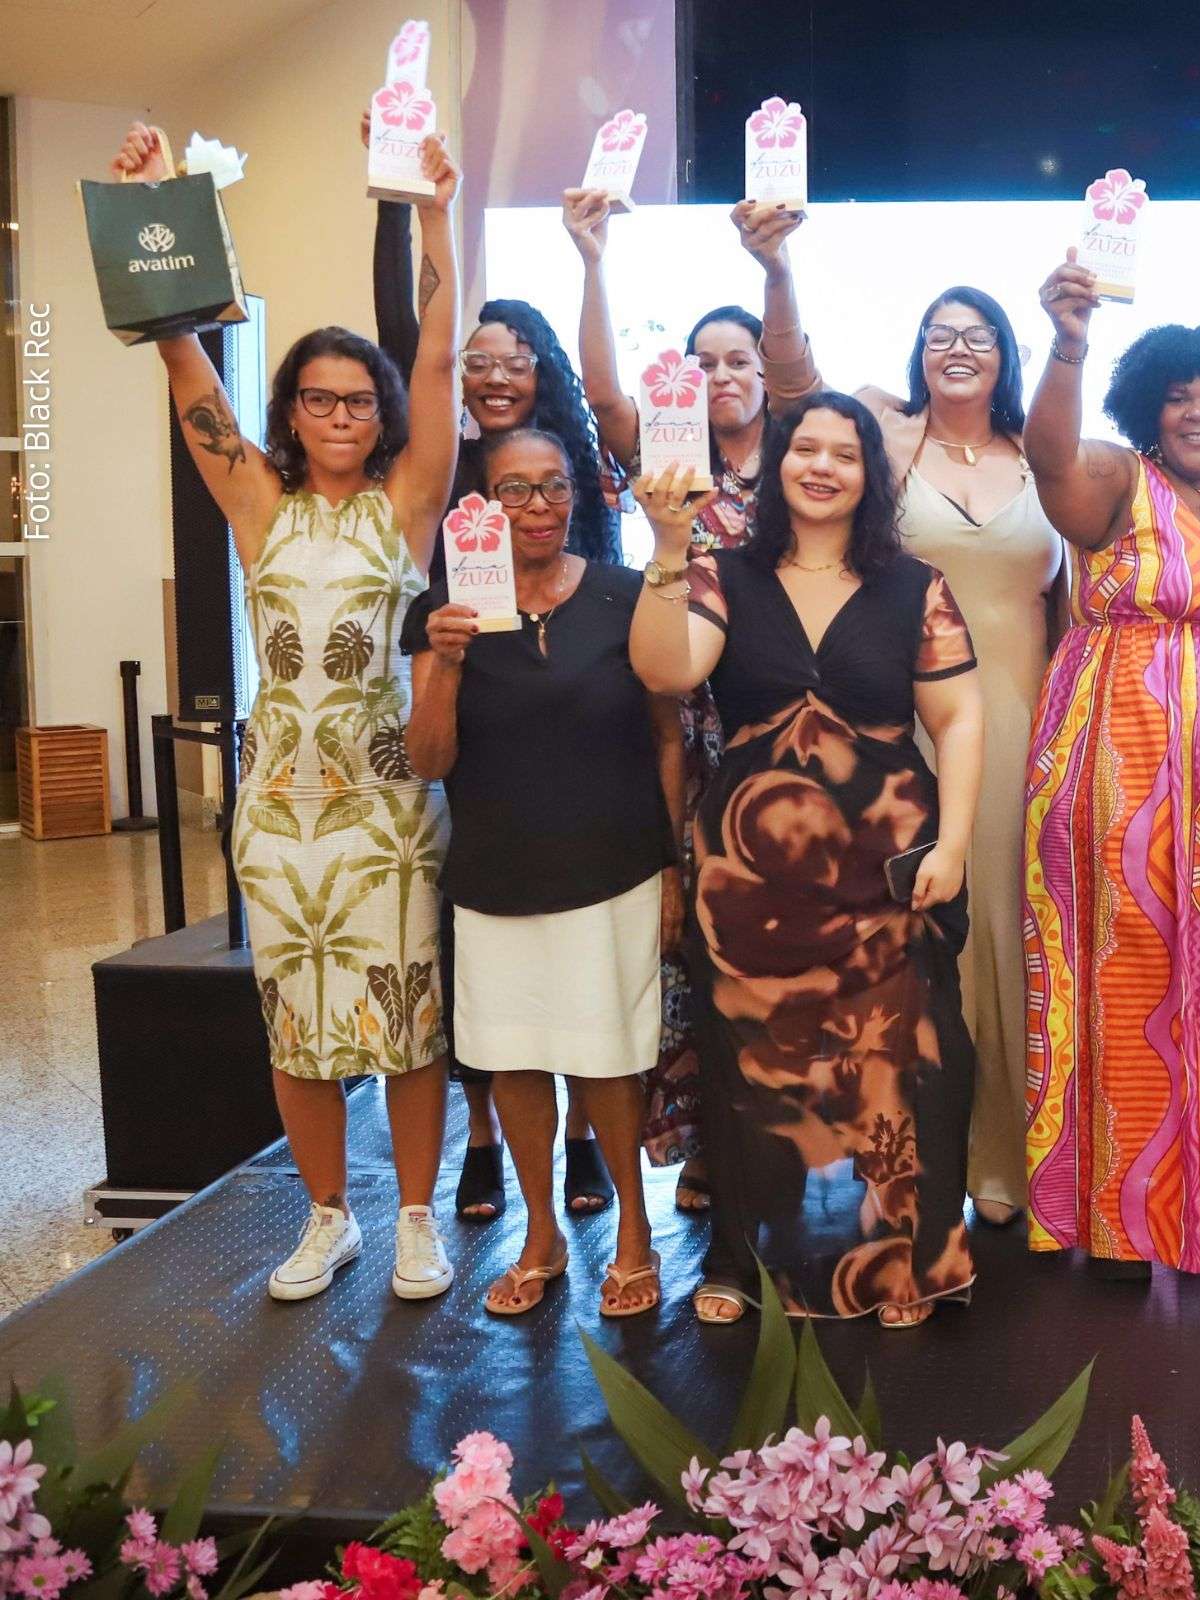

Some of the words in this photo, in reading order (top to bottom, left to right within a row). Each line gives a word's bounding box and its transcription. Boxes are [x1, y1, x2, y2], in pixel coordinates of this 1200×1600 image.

[1086, 237, 1136, 256] ZUZU
[128, 254, 195, 273] avatim
[651, 427, 703, 443] ZUZU
[457, 569, 508, 587] ZUZU
